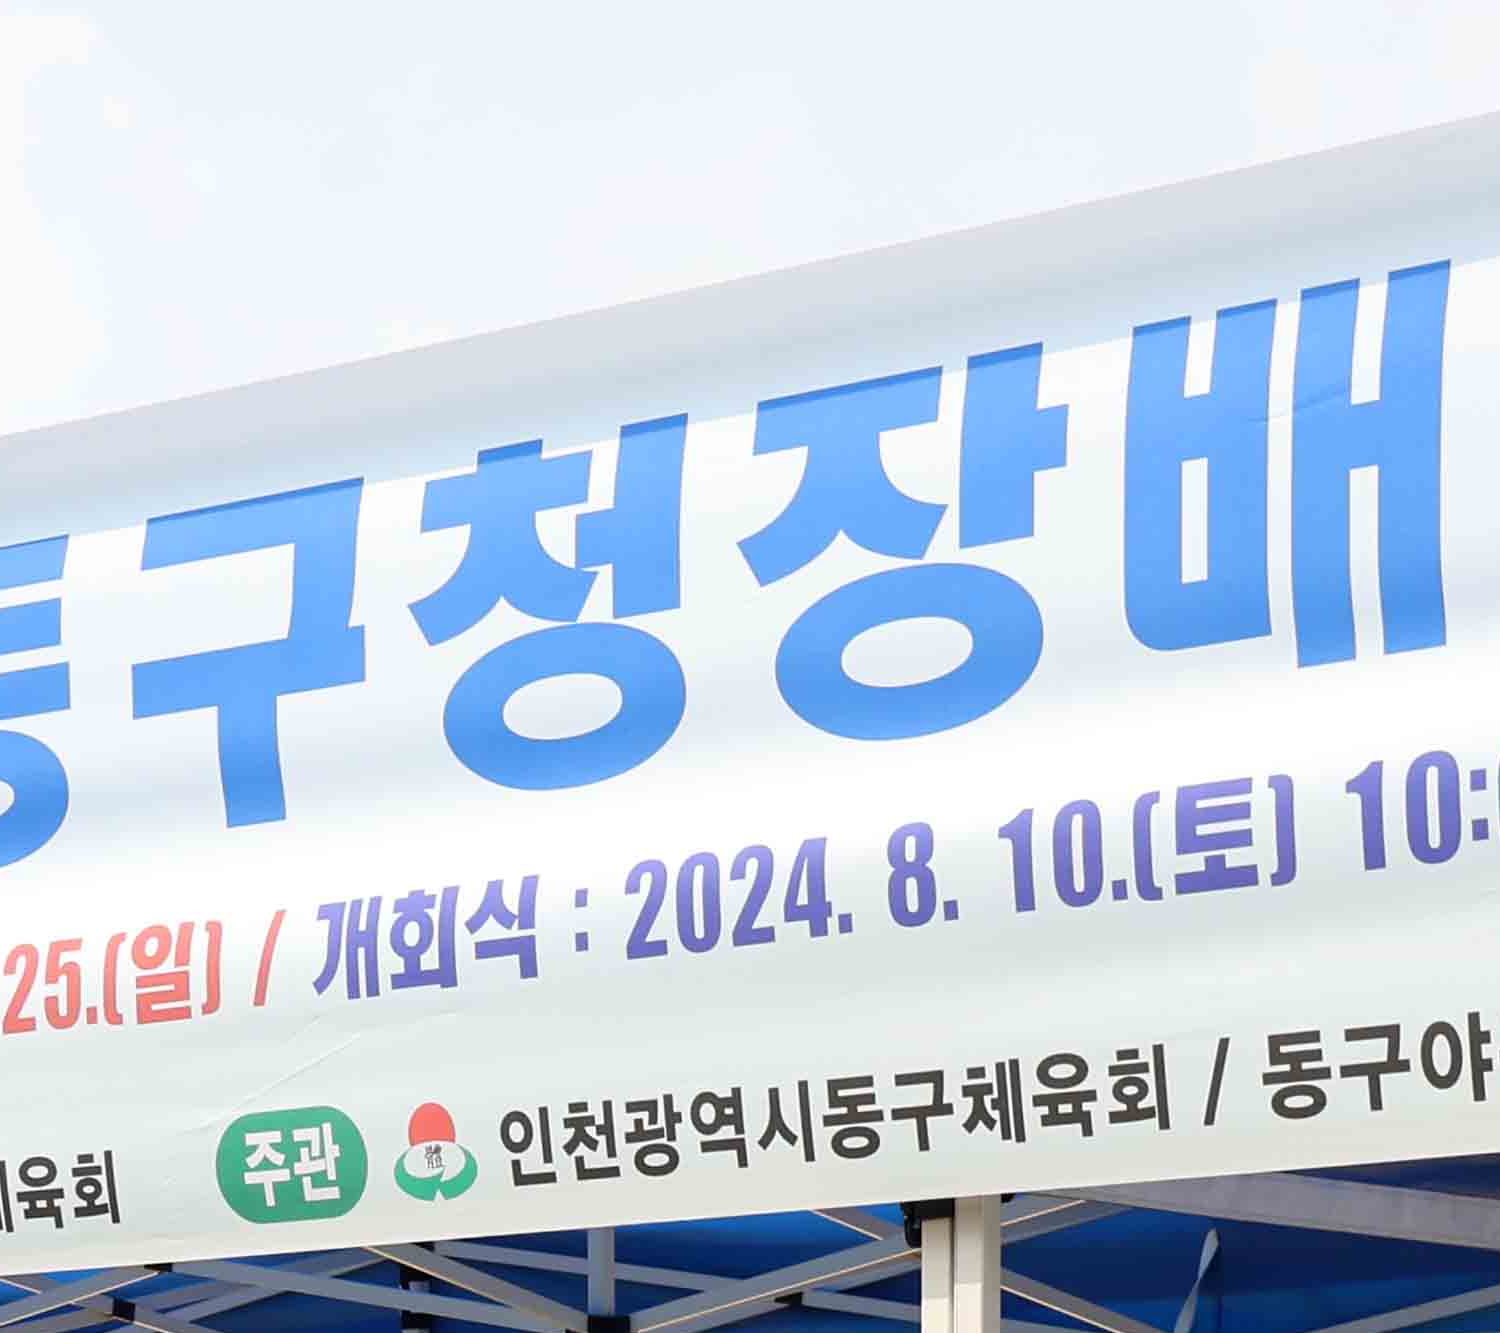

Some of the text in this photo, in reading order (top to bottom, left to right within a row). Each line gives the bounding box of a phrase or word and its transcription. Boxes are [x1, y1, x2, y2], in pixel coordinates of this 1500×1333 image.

[2, 919, 223, 1035] 25.(일)
[312, 875, 539, 1002] 개회식
[624, 838, 854, 961] 2024.
[887, 822, 959, 928] 8.
[998, 775, 1298, 913] 10.(토)
[243, 1121, 344, 1209] 주관
[499, 1042, 1171, 1188] 인천광역시동구체육회
